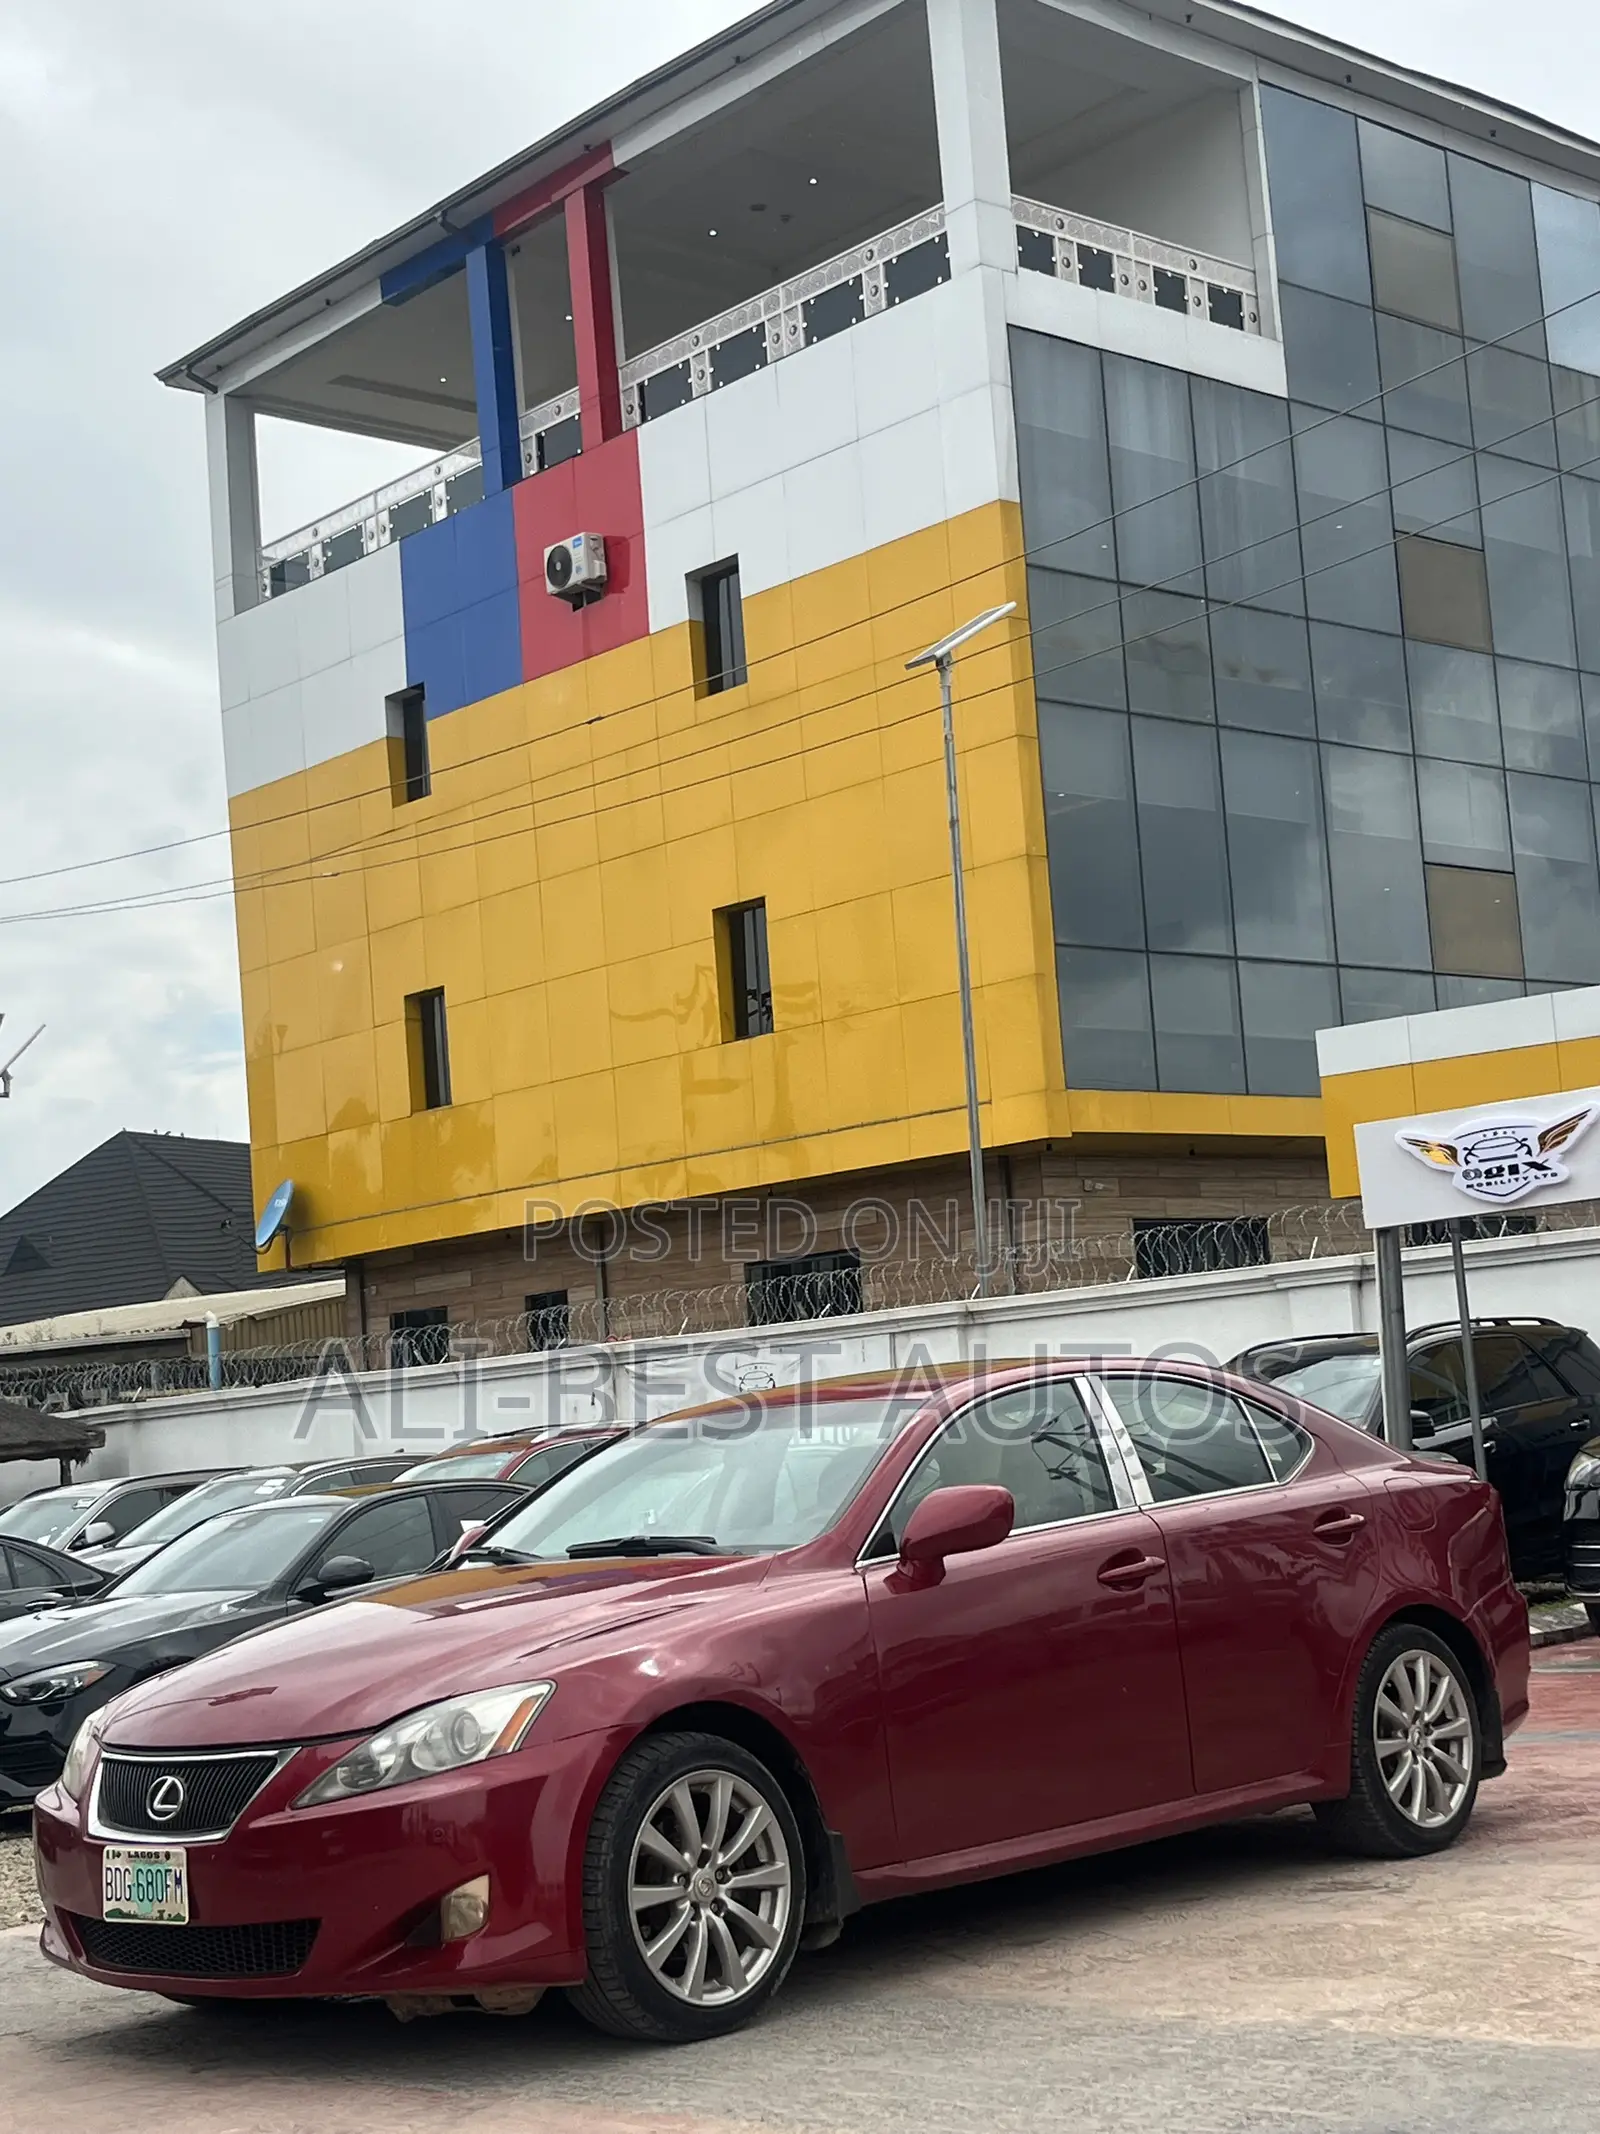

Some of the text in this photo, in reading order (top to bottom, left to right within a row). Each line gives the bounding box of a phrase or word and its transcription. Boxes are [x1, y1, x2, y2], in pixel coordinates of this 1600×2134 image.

[1466, 1172, 1558, 1189] MOBILITY LTD
[127, 1850, 160, 1859] LAGOS
